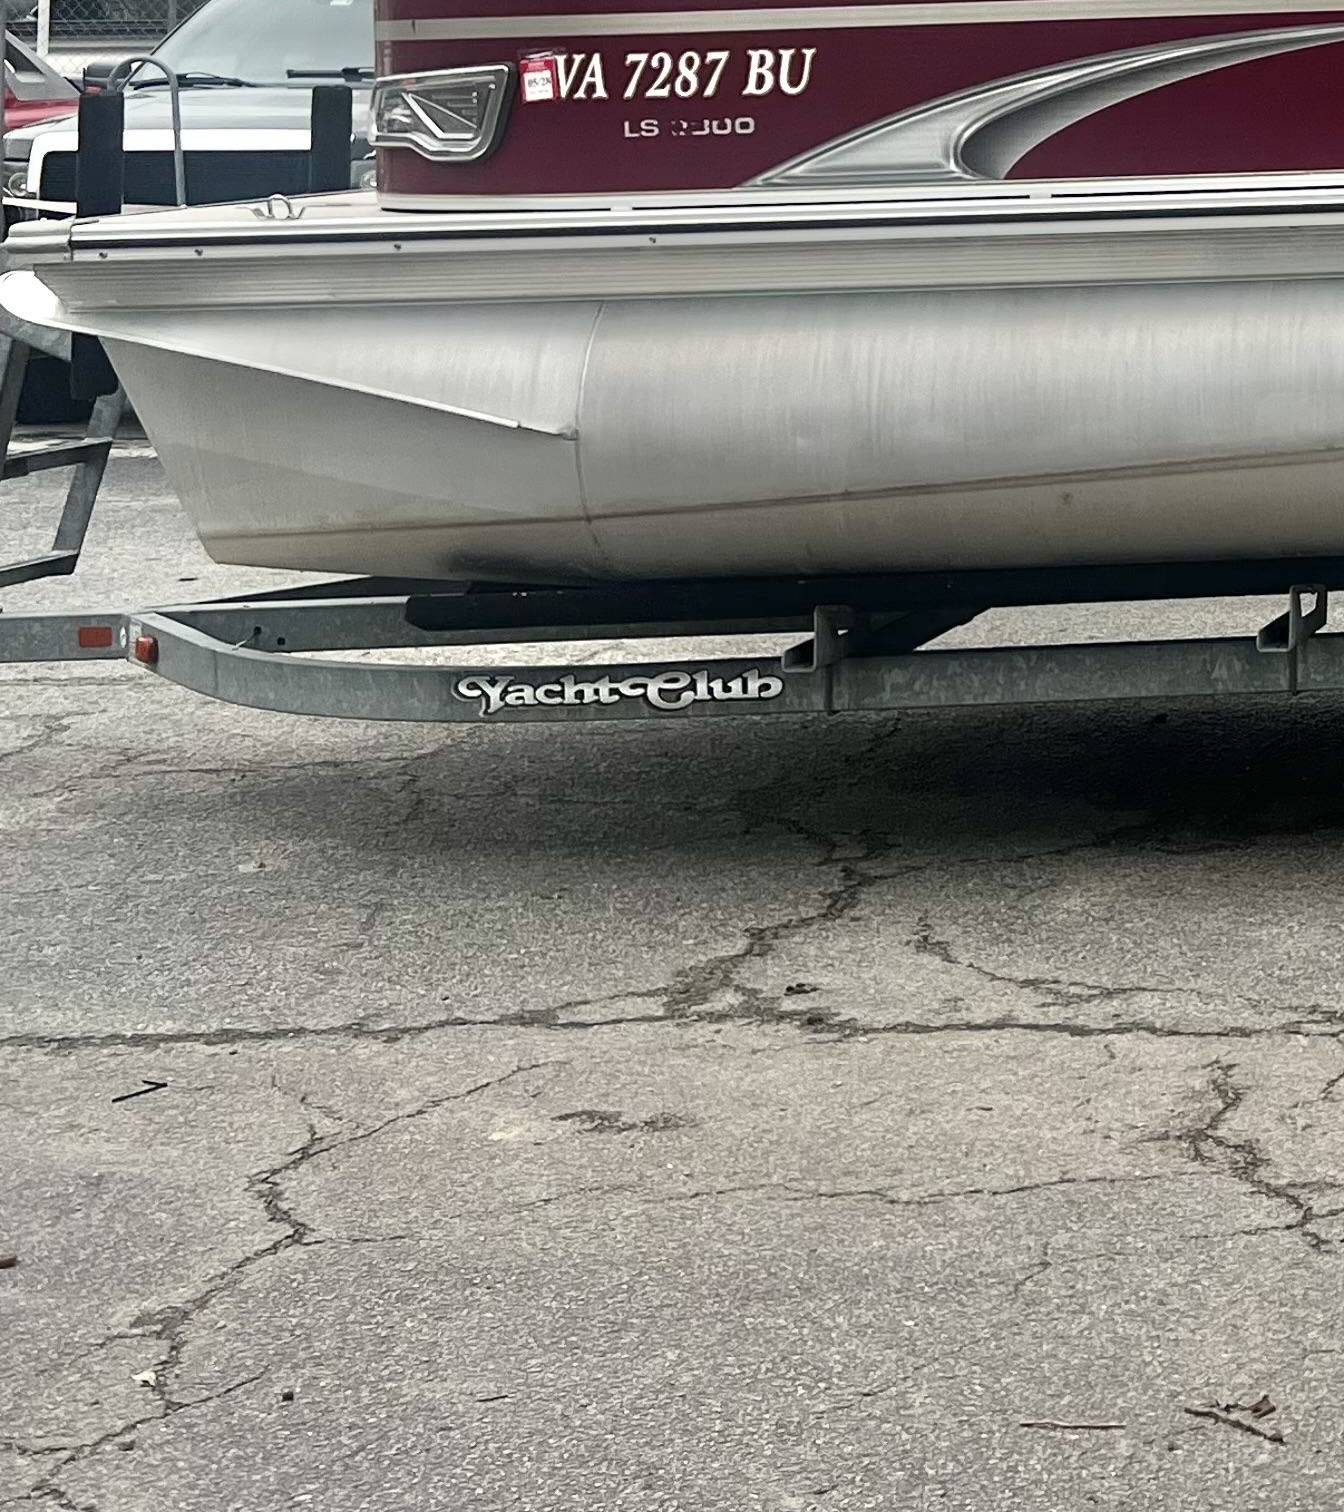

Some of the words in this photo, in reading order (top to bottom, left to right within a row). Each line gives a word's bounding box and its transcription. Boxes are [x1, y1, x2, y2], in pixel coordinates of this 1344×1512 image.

[554, 52, 609, 100] VA
[623, 51, 729, 99] 7287
[743, 49, 816, 95] BU
[623, 119, 660, 138] LS
